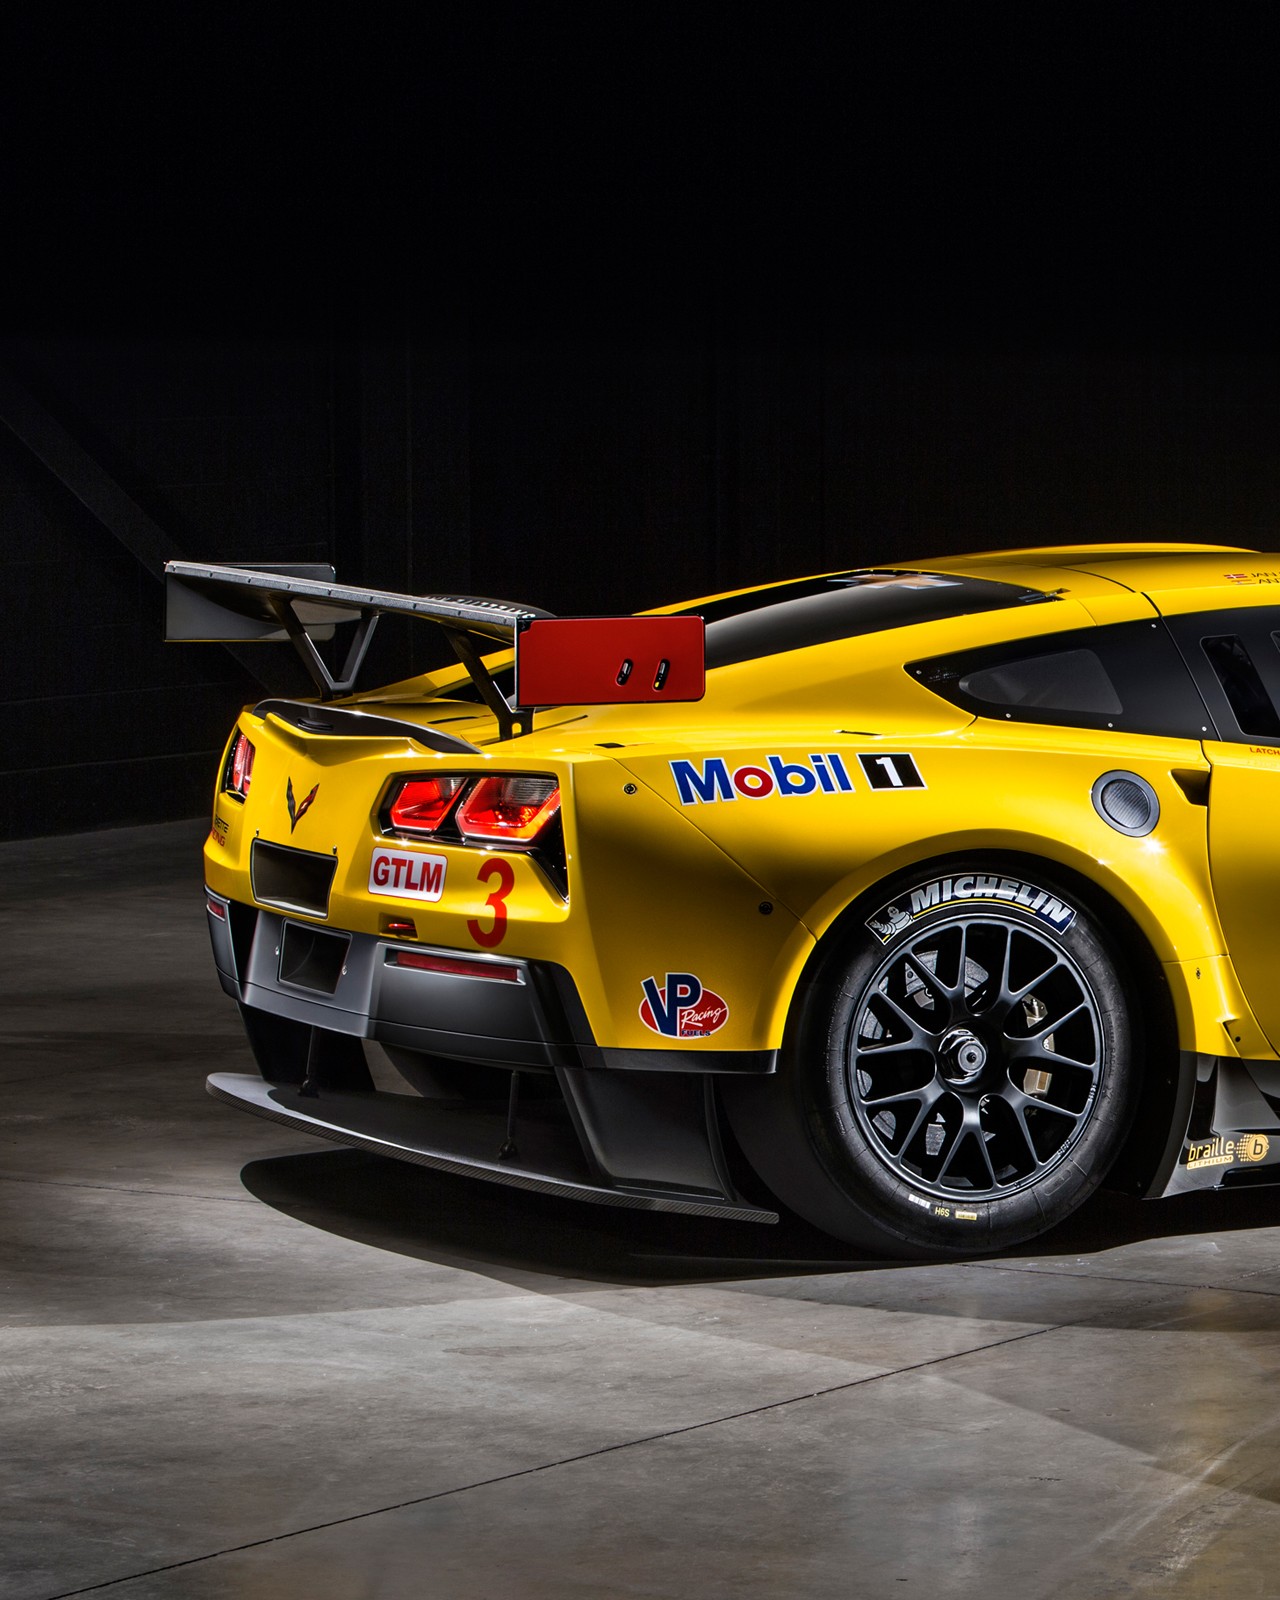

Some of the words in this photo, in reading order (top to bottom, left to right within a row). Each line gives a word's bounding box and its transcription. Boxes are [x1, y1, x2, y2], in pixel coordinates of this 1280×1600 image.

[1250, 747, 1280, 755] LATCH
[668, 753, 857, 806] Mobil
[875, 757, 904, 787] 1
[373, 855, 443, 894] GTLM
[467, 858, 515, 948] 3
[910, 876, 1073, 924] MICHELIN
[640, 972, 703, 1037] VP
[681, 1006, 728, 1029] Racing
[681, 1029, 711, 1037] FUELS
[1188, 1137, 1235, 1161] braille
[934, 1206, 950, 1218] H6S
